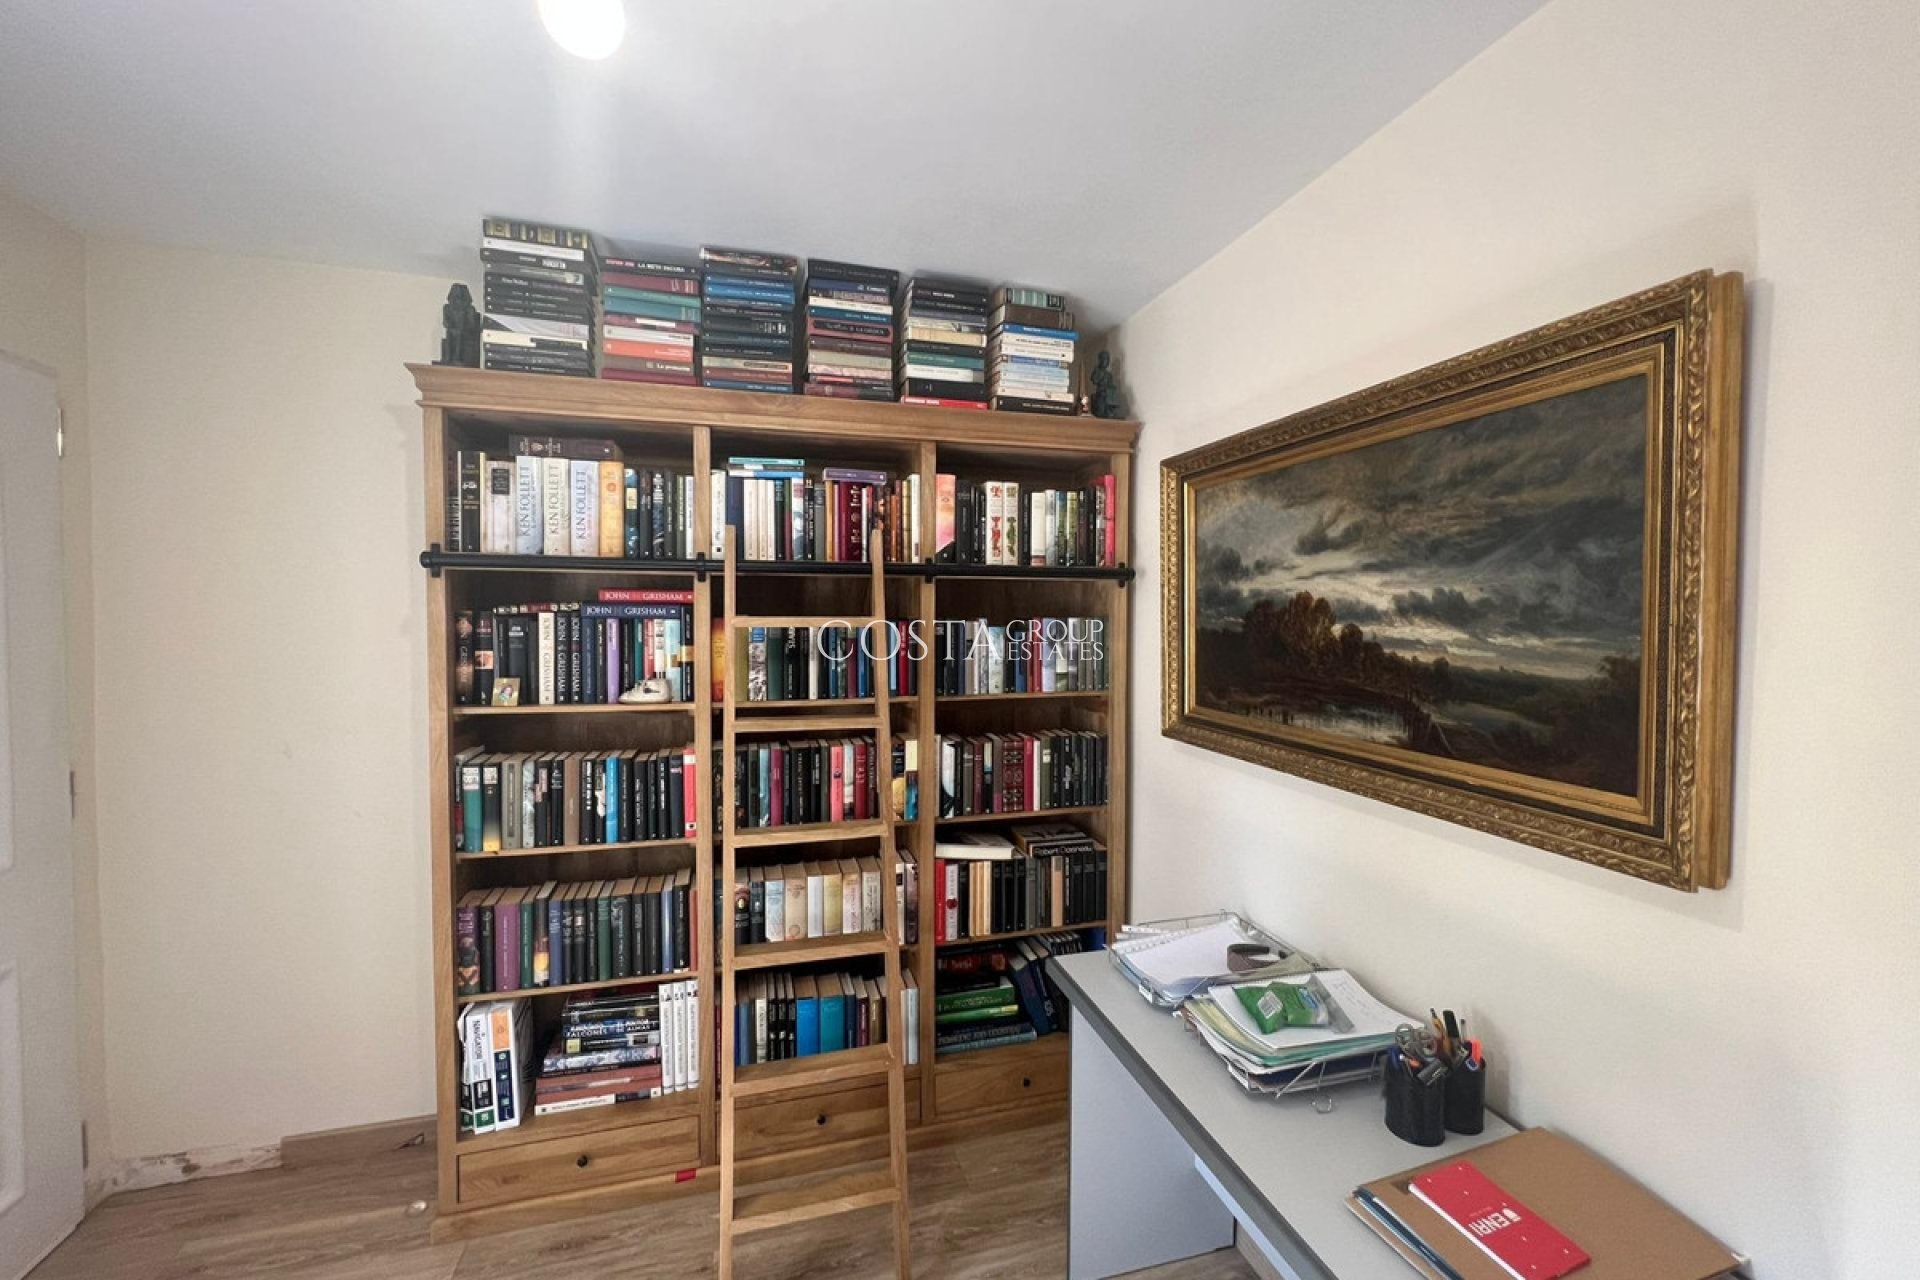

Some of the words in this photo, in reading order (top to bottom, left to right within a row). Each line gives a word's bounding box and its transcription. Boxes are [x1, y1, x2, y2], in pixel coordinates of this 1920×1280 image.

[519, 466, 531, 511] FOLLETT
[548, 465, 559, 510] FOLLETT
[575, 471, 586, 514] FOLLETT
[519, 514, 531, 537] KEN
[548, 512, 559, 535] KEN
[575, 517, 586, 539] KEN
[605, 591, 630, 600] JOHN
[642, 591, 684, 601] GRISHAM
[586, 606, 612, 615] JOHN
[624, 606, 667, 615] GRISHAM
[543, 617, 553, 640] JOHN
[557, 617, 567, 640] JOHN
[571, 617, 580, 640] JOHN
[543, 652, 553, 692] GRISHAM
[557, 652, 567, 691] GRISHAM
[572, 652, 580, 691] GRISHAM
